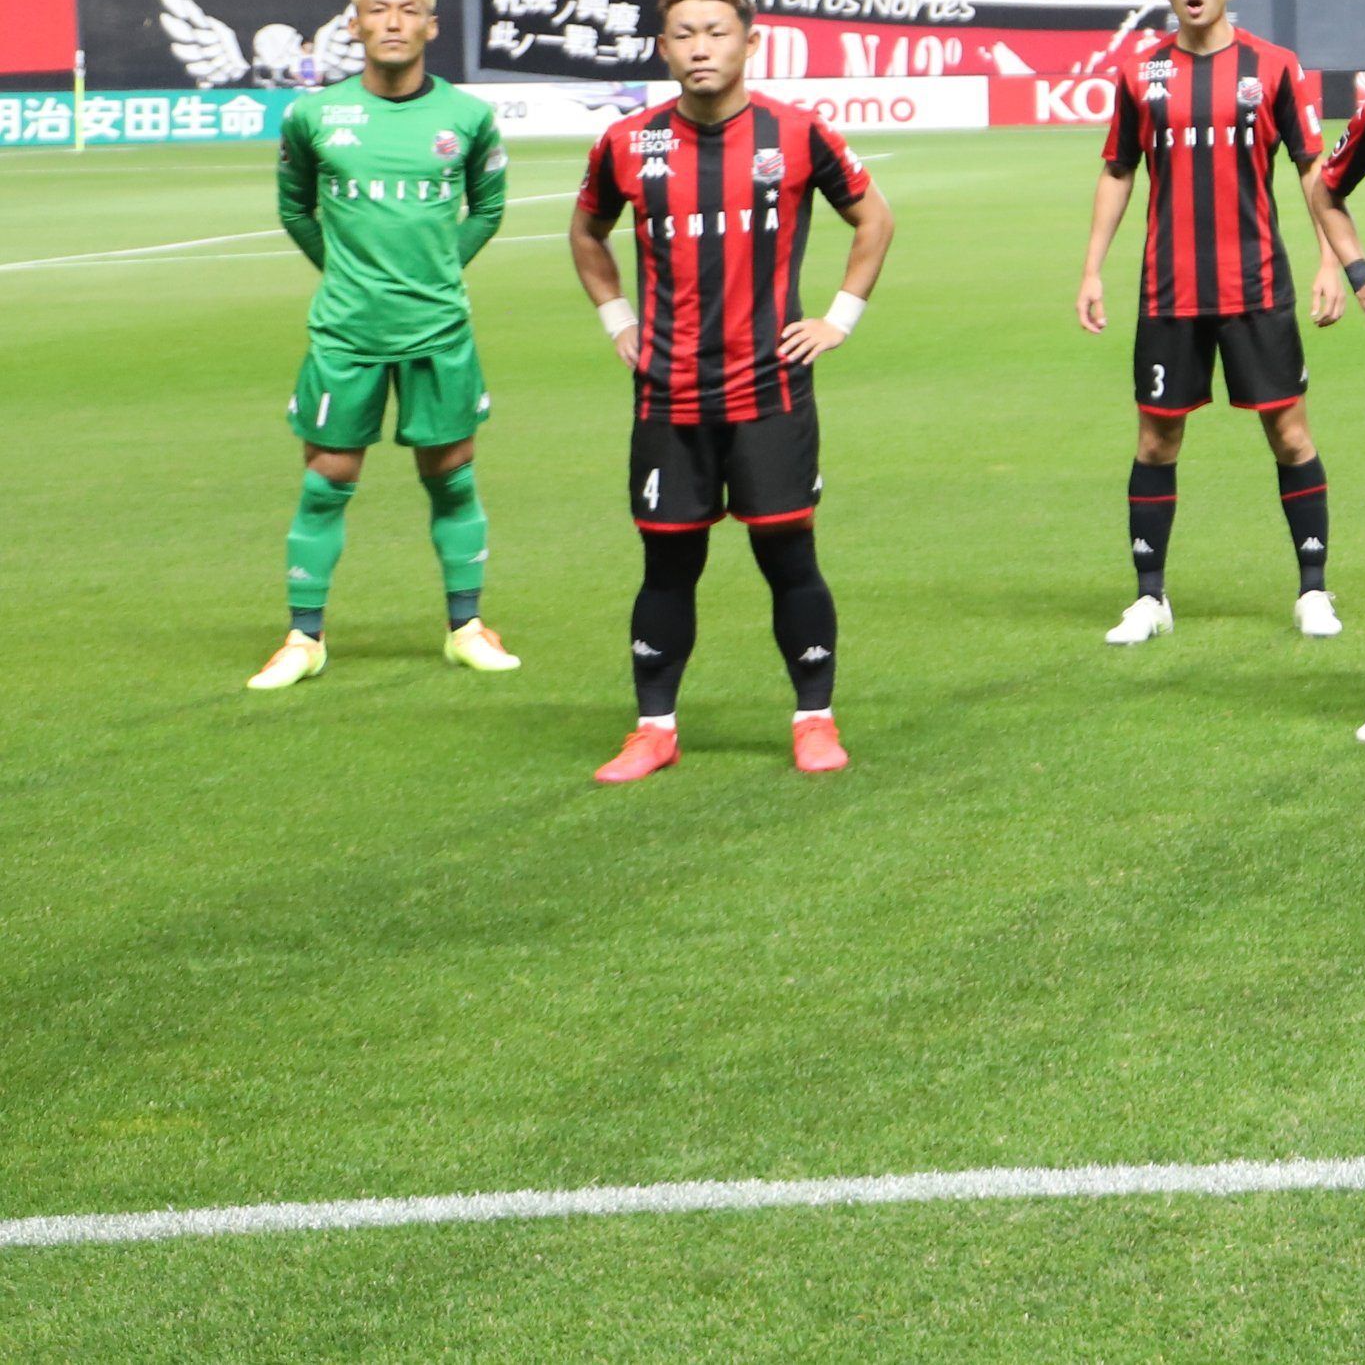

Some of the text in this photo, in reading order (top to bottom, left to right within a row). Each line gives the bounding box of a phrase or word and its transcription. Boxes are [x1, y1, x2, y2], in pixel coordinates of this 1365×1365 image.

[1138, 67, 1178, 81] RESORT
[1139, 59, 1174, 71] TOHO
[629, 128, 674, 142] TOHO
[629, 138, 681, 154] RESORT
[1153, 126, 1255, 148] ISHIYA
[331, 179, 452, 201] ISHIYA
[646, 207, 780, 240] ISHIYA
[1150, 363, 1166, 399] 3
[315, 391, 331, 428] 1
[642, 467, 661, 510] 4
